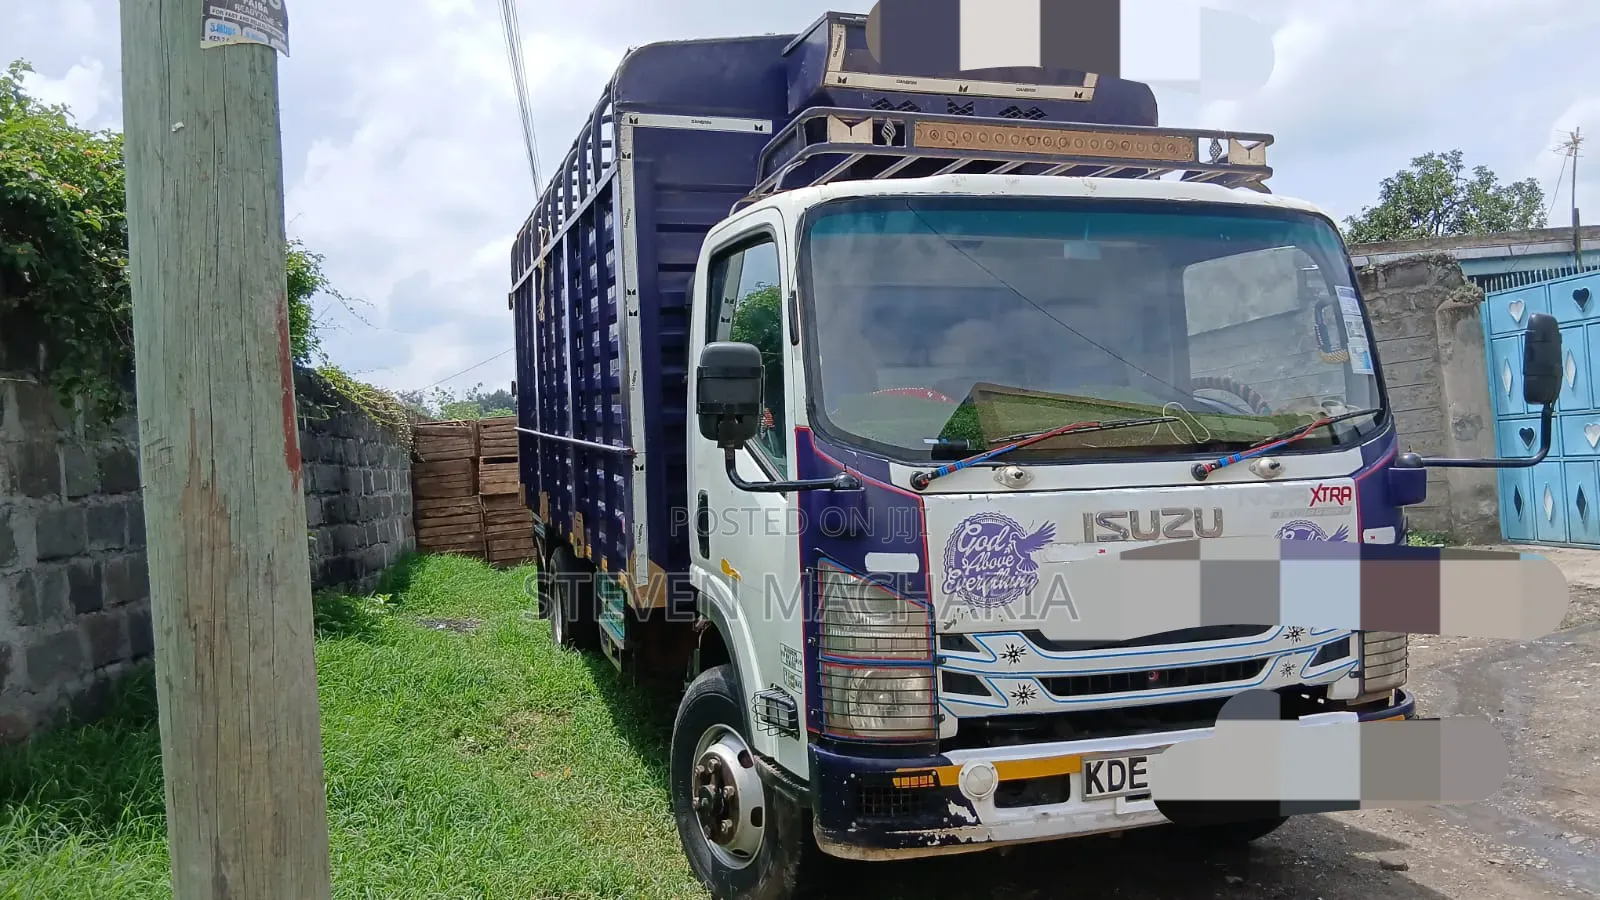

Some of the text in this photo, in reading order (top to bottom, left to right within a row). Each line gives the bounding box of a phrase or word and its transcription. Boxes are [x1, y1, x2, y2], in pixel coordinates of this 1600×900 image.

[1309, 483, 1352, 507] XTRA
[957, 521, 1010, 556] God
[1082, 507, 1224, 543] ISUZU
[962, 552, 1015, 575] Above
[942, 567, 1039, 597] Everything
[1085, 756, 1148, 794] KDE
